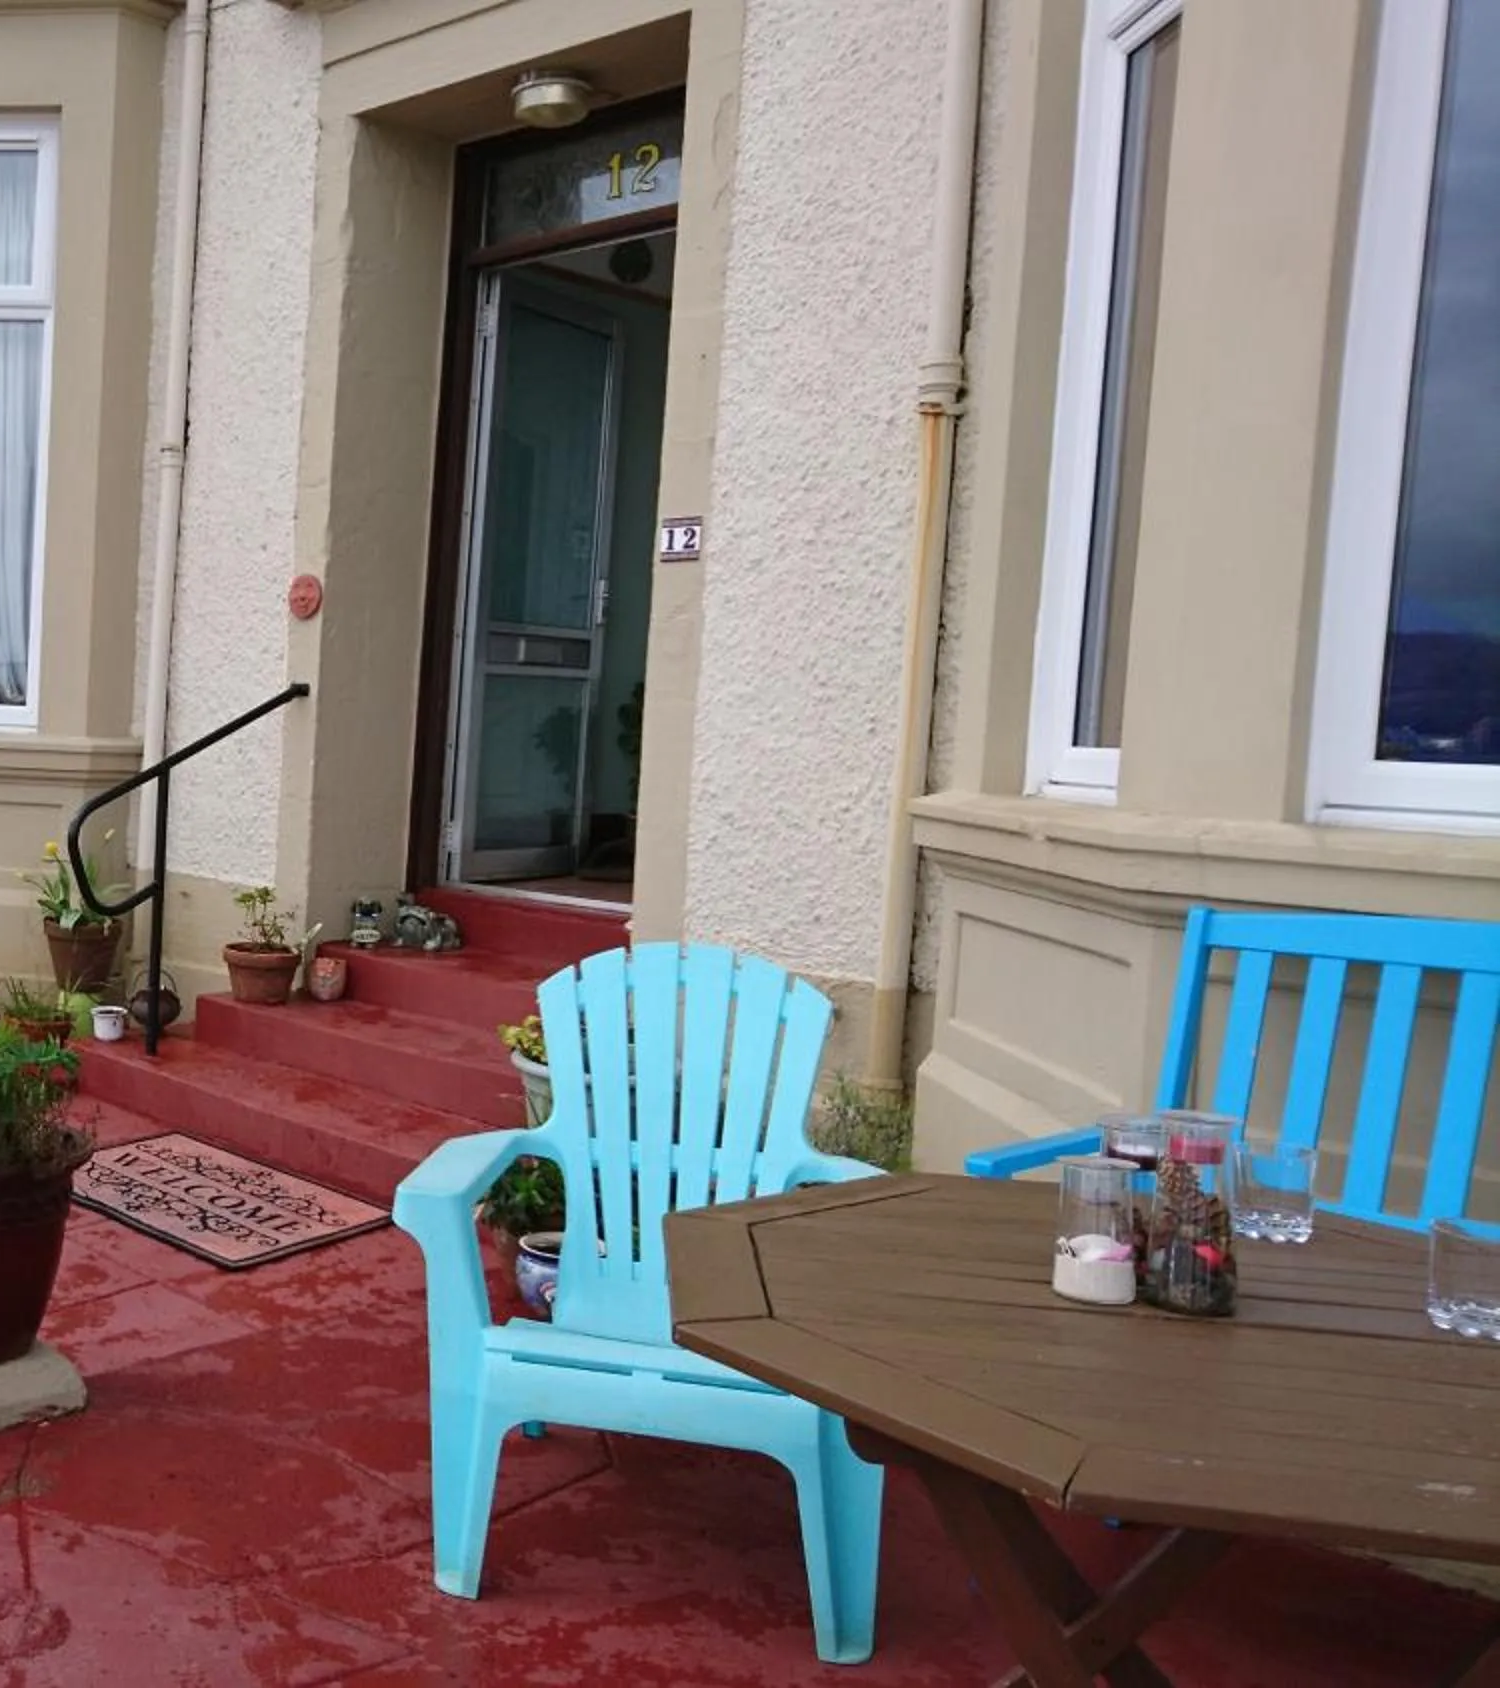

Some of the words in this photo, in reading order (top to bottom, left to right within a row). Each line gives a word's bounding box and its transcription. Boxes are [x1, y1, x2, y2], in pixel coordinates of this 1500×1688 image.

[607, 143, 660, 200] 12
[665, 527, 697, 551] 12
[112, 1151, 301, 1237] WELCOME
